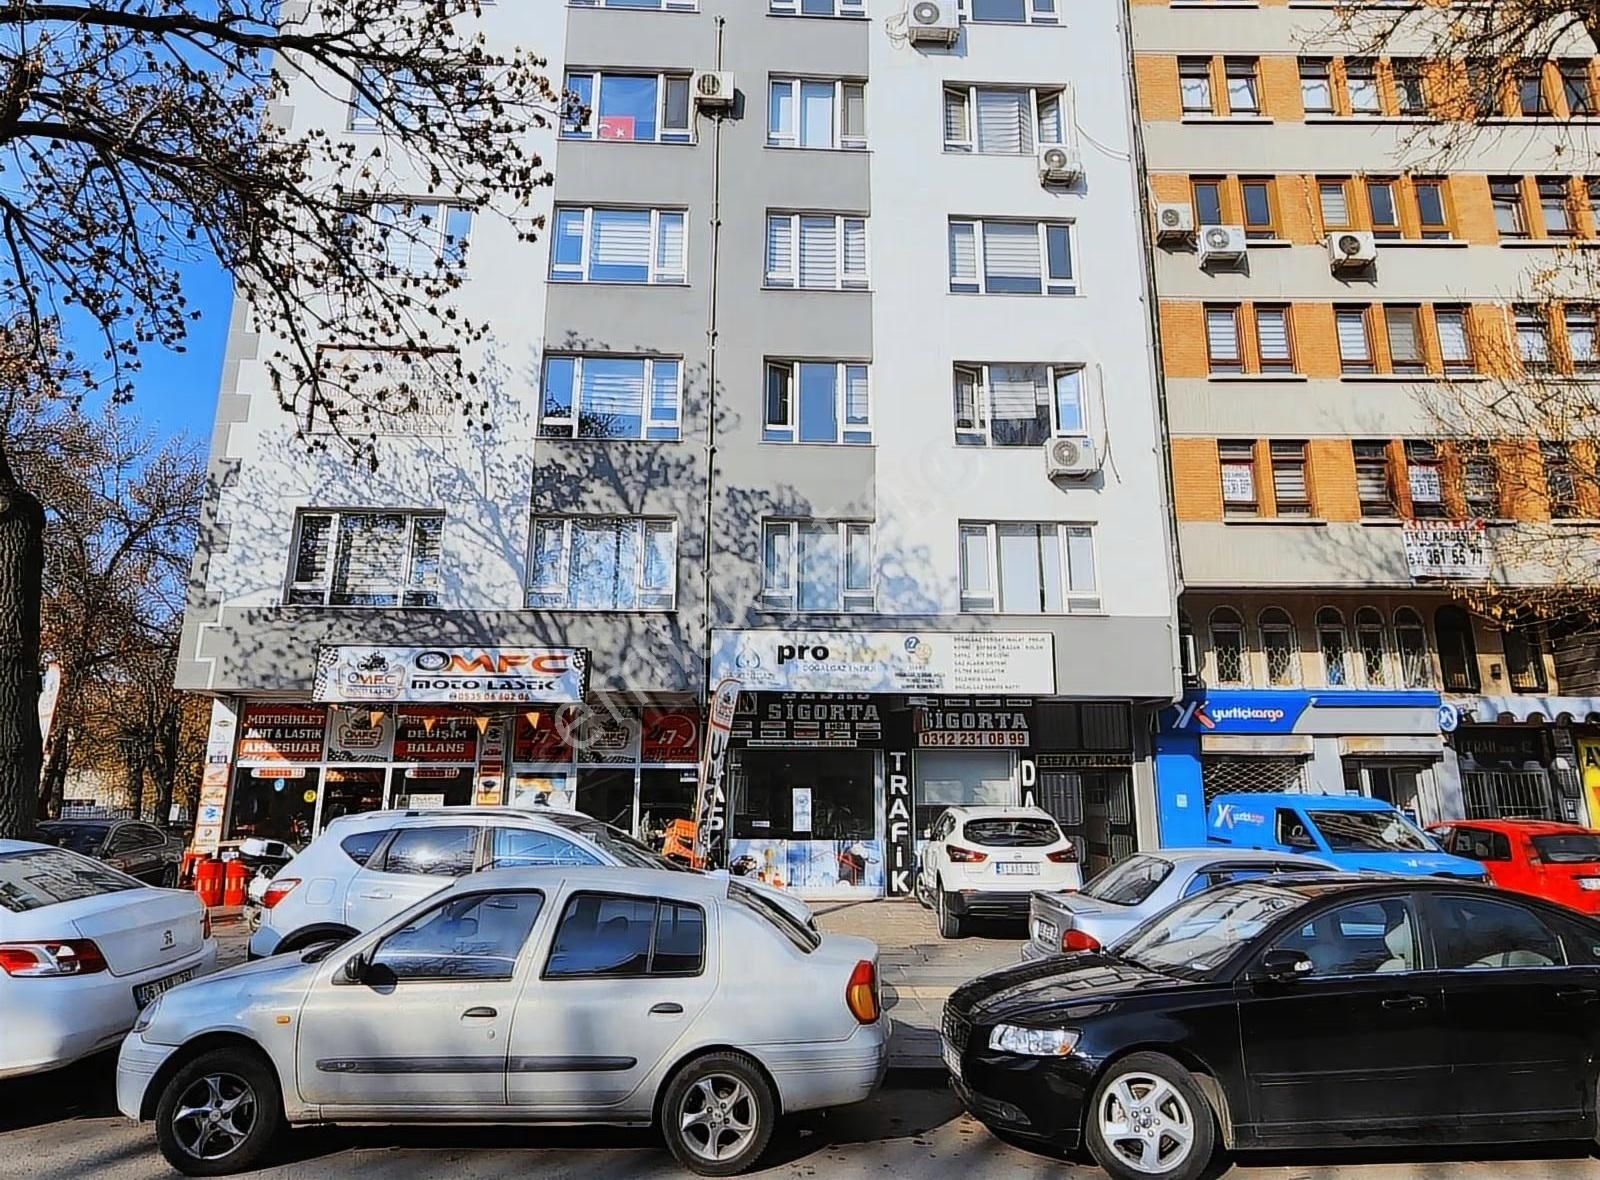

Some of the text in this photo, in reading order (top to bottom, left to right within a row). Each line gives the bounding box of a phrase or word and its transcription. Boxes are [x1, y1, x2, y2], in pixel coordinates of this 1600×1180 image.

[1426, 548, 1446, 565] 361
[777, 644, 830, 664] pro
[415, 651, 570, 674] OMFC
[348, 672, 396, 684] OMFC
[411, 680, 480, 690] MOTO
[768, 701, 880, 720] SİGORTA
[248, 713, 325, 725] MOTOSİKLET
[922, 733, 1025, 745] 0312 231 08 99
[243, 743, 320, 752] AKSESUAR
[407, 743, 465, 753] BALANS
[888, 751, 910, 893] TRAFİK
